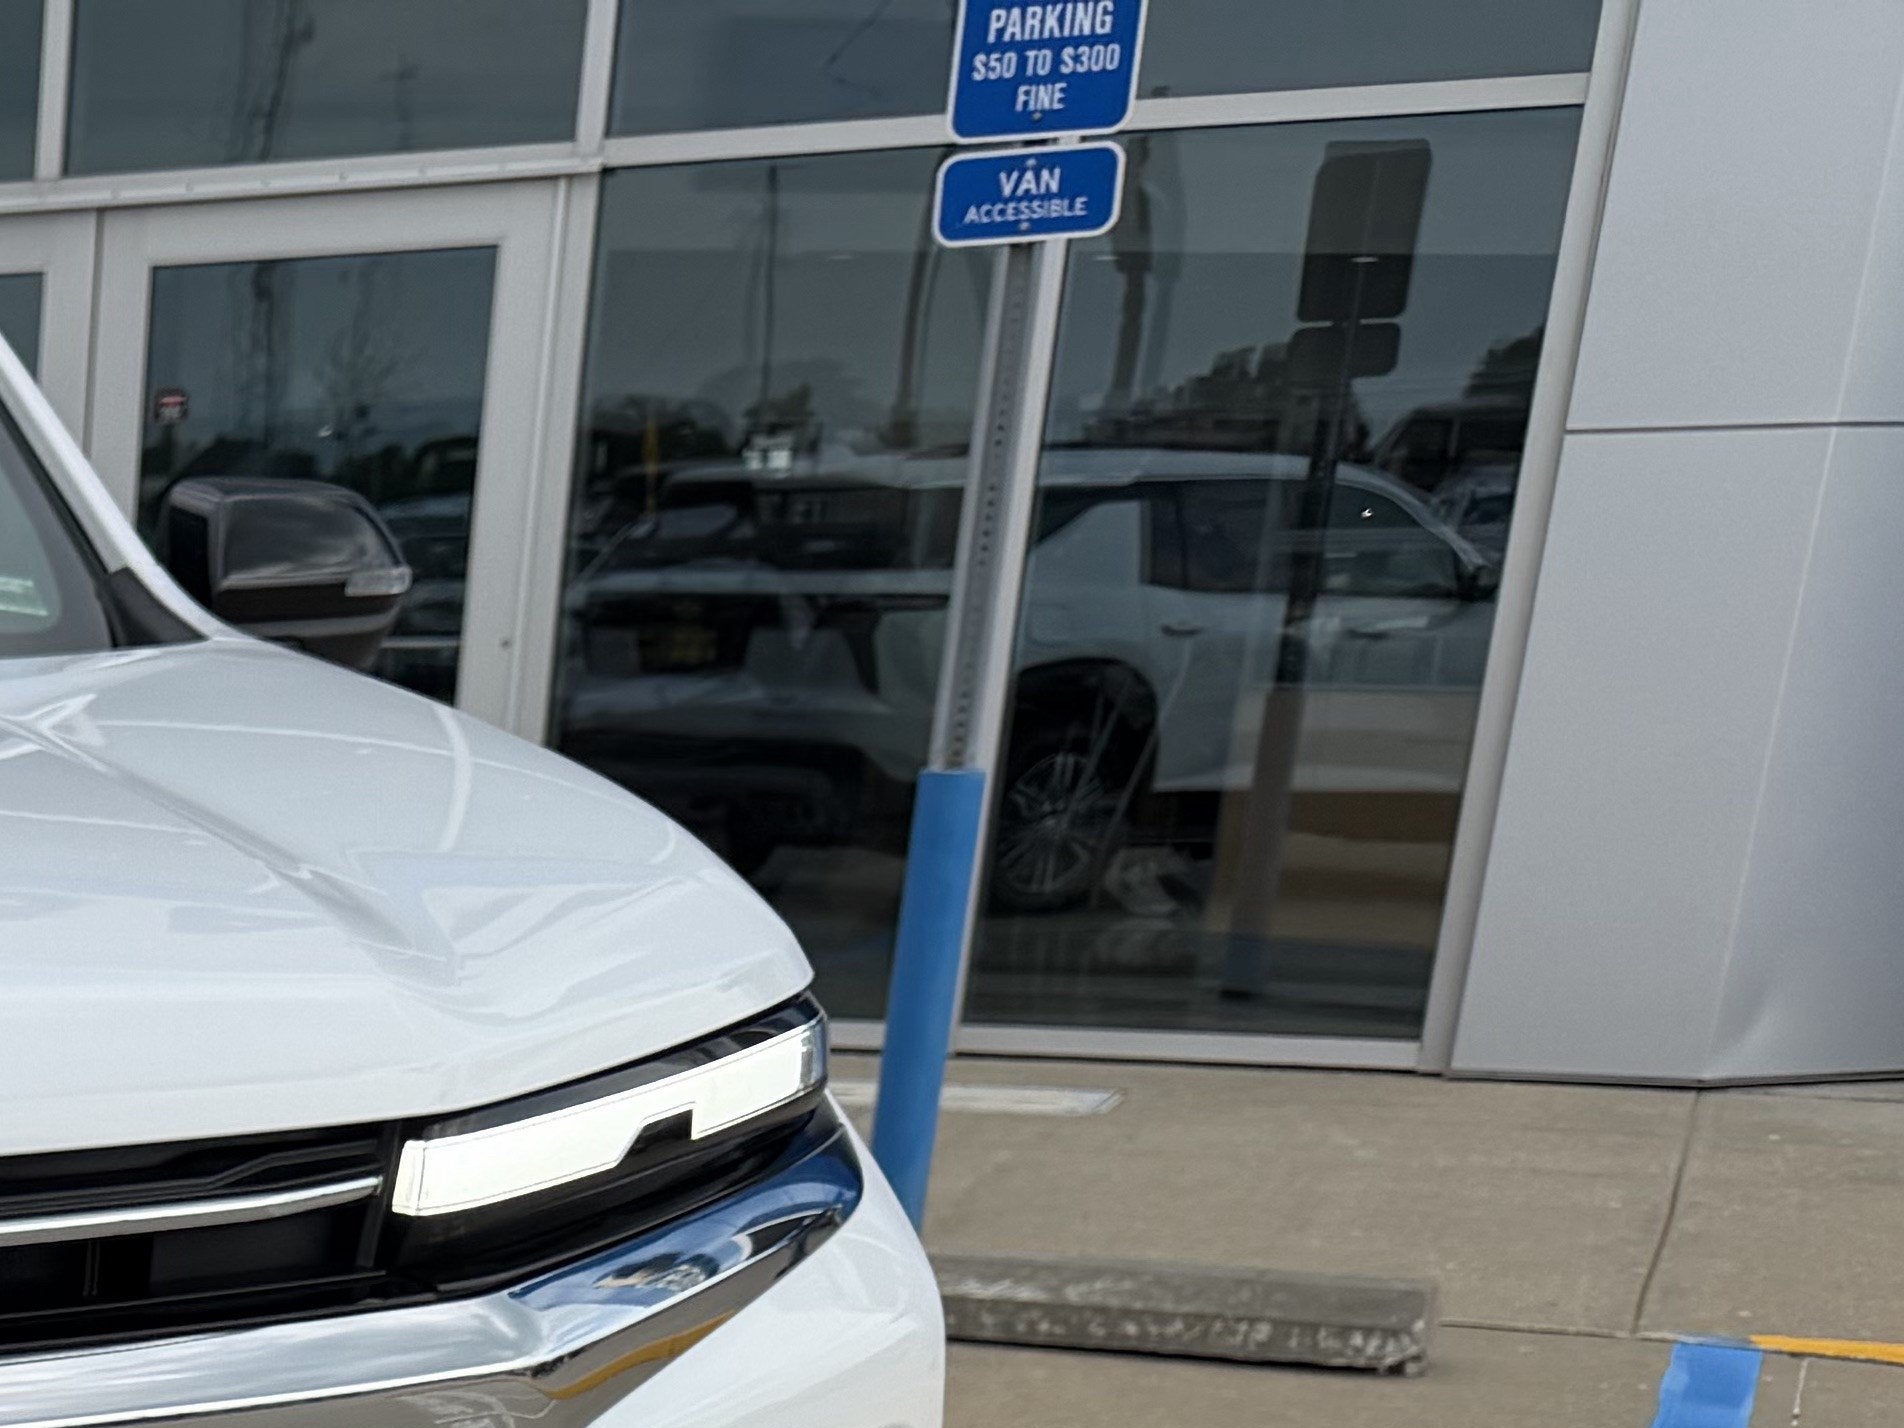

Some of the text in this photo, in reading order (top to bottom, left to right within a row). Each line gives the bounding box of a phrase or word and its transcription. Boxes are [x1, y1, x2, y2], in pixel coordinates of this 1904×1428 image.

[987, 1, 1114, 43] PARKING
[972, 43, 1121, 81] $50 TO $300
[1015, 82, 1068, 112] FINE
[999, 166, 1061, 198] VAN
[963, 196, 1088, 225] ACCESSIBLE
